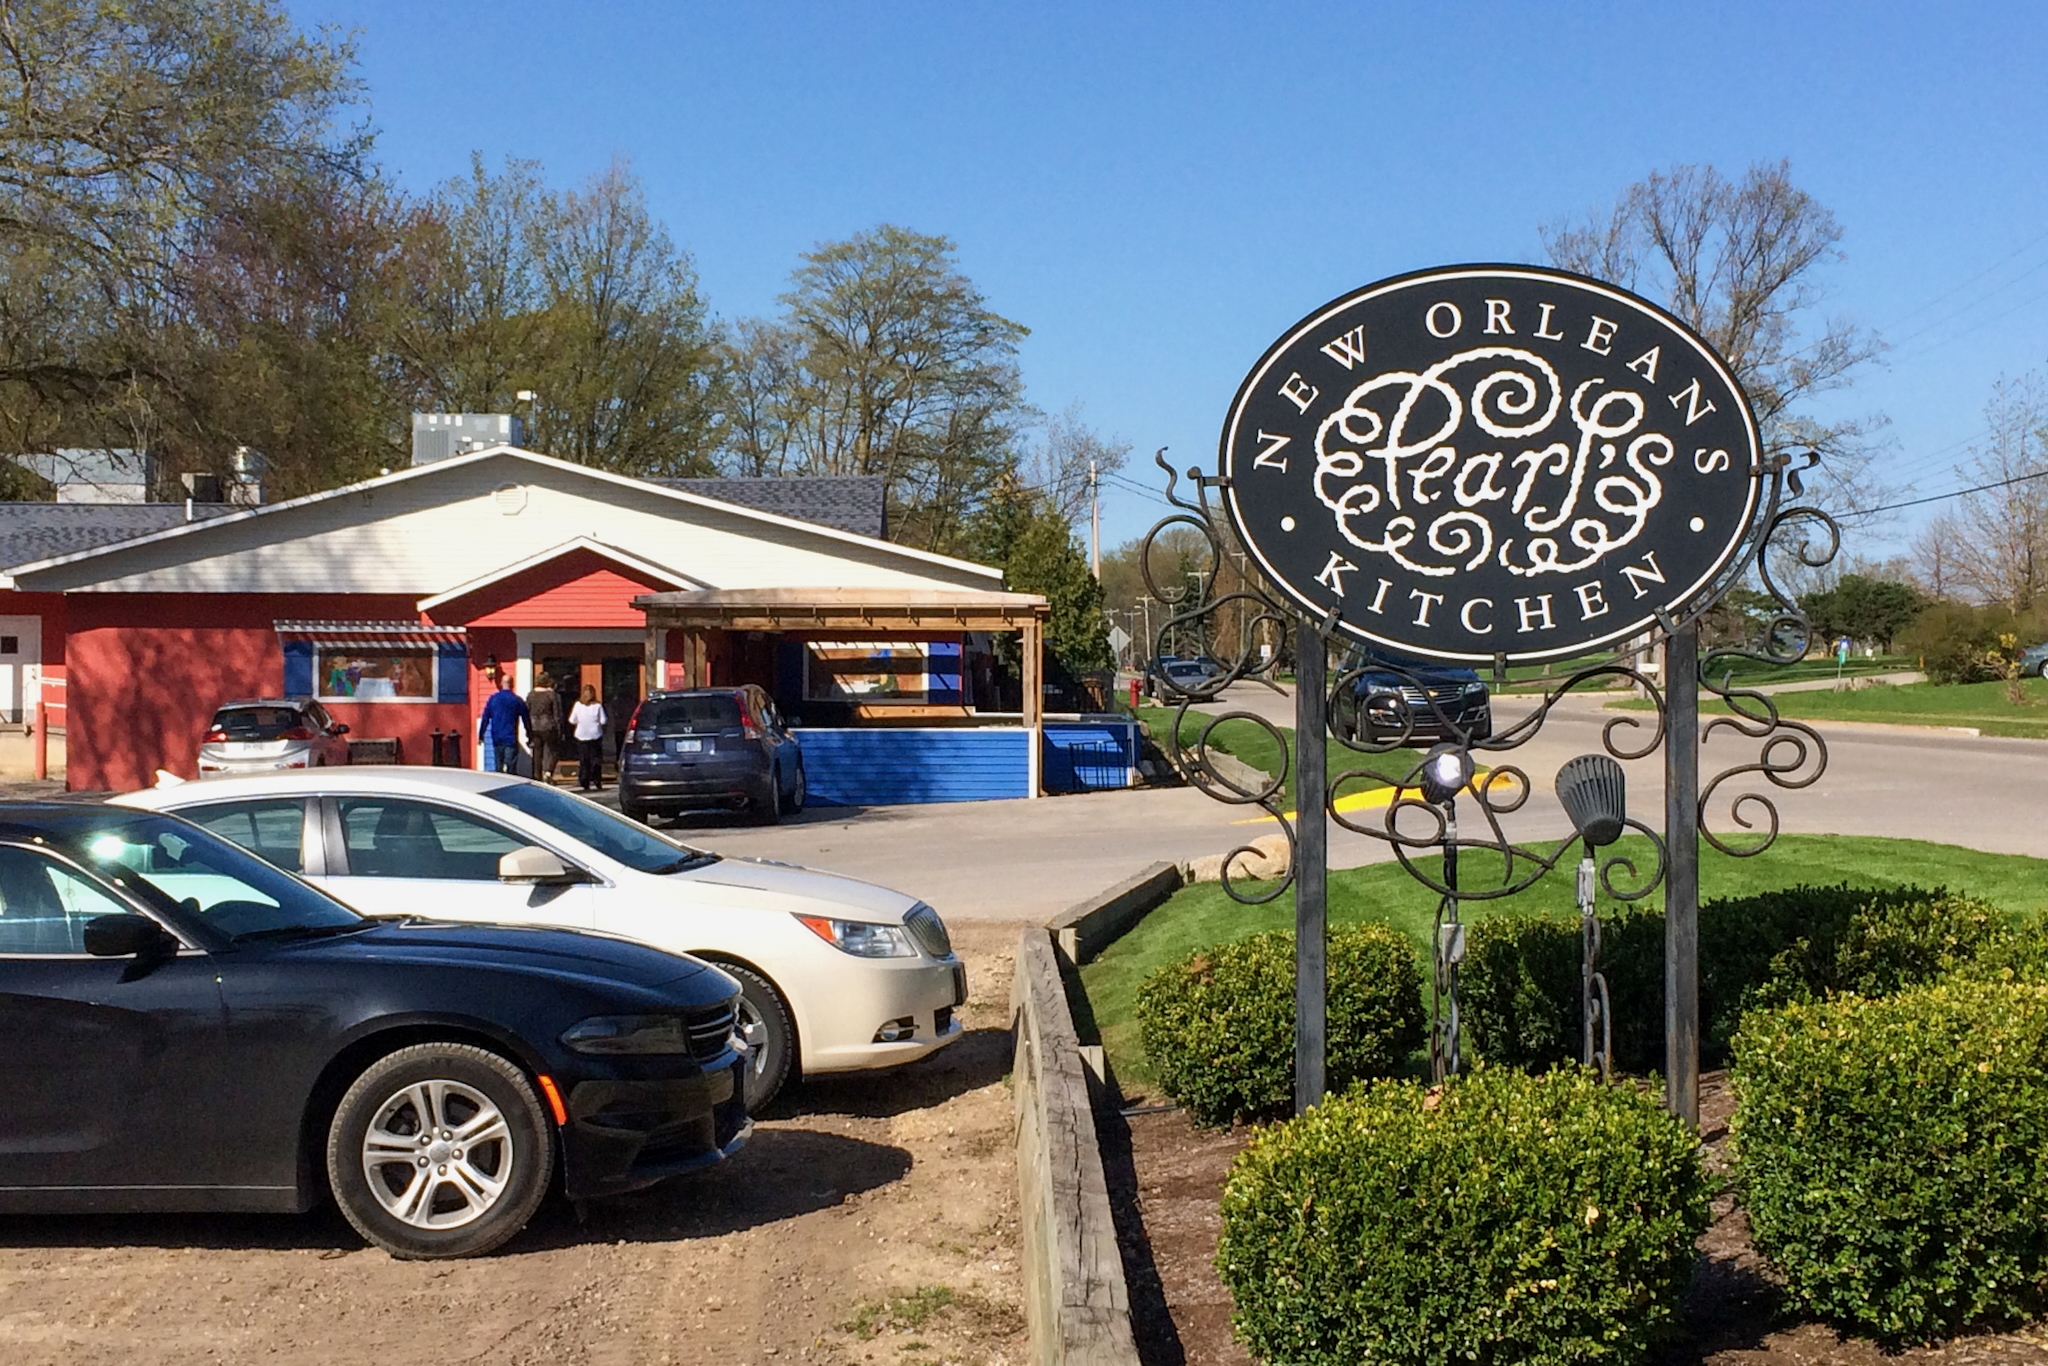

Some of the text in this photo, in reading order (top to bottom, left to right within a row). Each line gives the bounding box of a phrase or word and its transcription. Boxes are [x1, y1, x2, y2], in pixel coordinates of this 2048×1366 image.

[1254, 299, 1730, 474] NEW ORLEANS
[1313, 550, 1666, 634] KITCHEN
